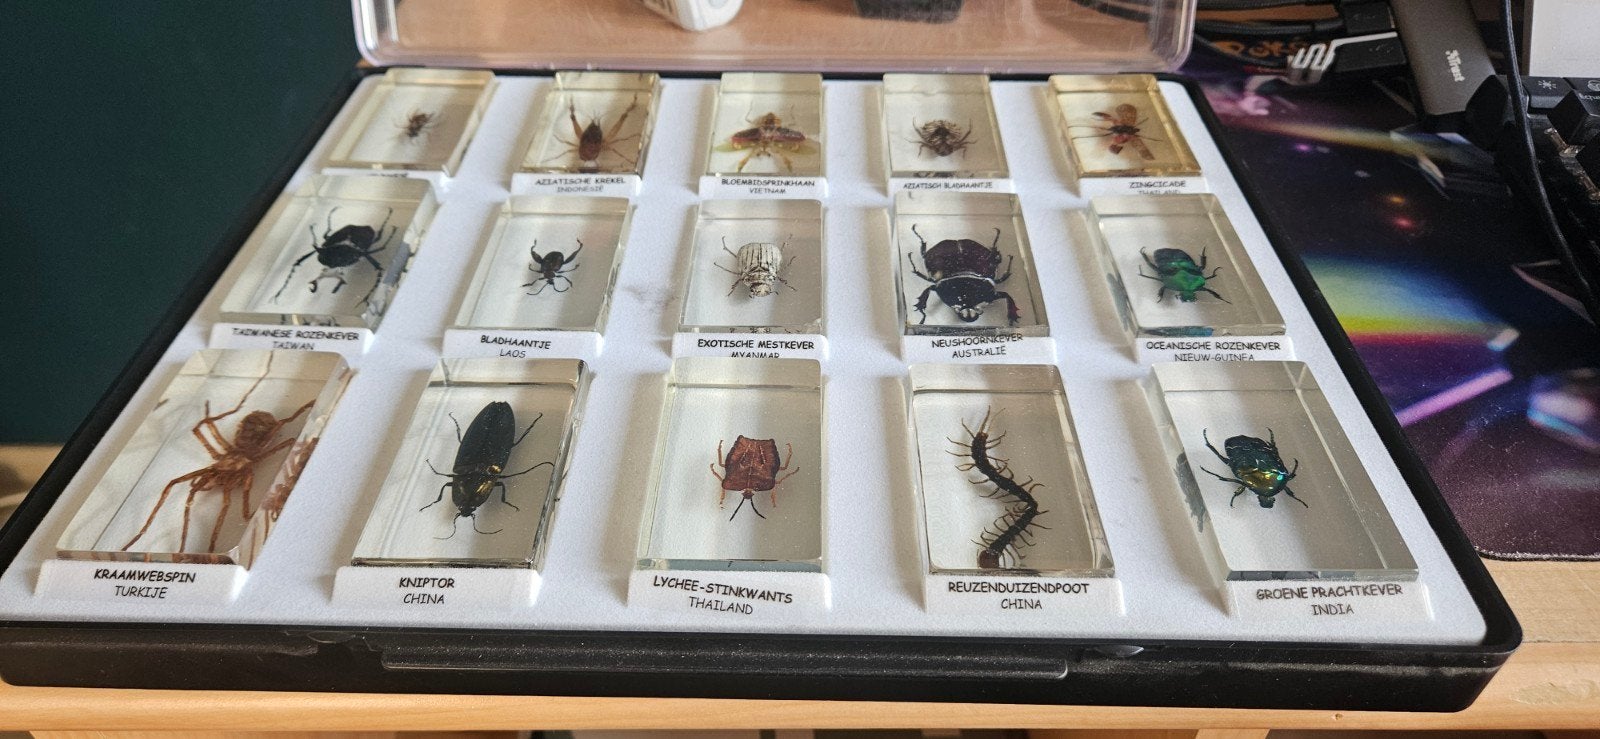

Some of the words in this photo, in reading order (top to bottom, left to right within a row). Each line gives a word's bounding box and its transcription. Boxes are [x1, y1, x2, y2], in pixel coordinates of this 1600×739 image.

[535, 178, 591, 186] AZIATISCHE
[721, 178, 815, 187] BLOEMBIDSPRINKHAAN
[1129, 180, 1186, 189] ZINGCICADE
[232, 327, 291, 339] TAIWANESE
[295, 330, 359, 341] ROZENKEVER
[272, 341, 314, 350] TAIWAN
[480, 334, 551, 350] BLADHAANTJE
[697, 338, 754, 349] EXOTISCHE
[757, 340, 815, 350] MESTKEVER
[931, 332, 1024, 349] NEUSHOORNKEVER
[1146, 341, 1212, 350] OCEANISCHE
[1215, 341, 1281, 350] ROZENKEVER
[499, 348, 526, 358] LAOS
[951, 345, 1007, 359] AUSTRALIE
[1174, 353, 1255, 362] NIEUW-GUINEA
[93, 568, 196, 583] KRAAMWEBSPIN
[399, 577, 455, 588] KNIPTOR
[948, 581, 1090, 594] REUZENDUIZENDPOOT
[114, 585, 168, 599] TURKIJE
[653, 575, 793, 604] LYCHEE-STINKWANTS
[1256, 587, 1309, 600] GROENE
[1311, 583, 1404, 598] PRACHTKEVER
[403, 593, 445, 604] CHINA
[1000, 598, 1043, 610] CHINA
[689, 596, 754, 615] THAILAND
[1311, 604, 1354, 616] INDIA
